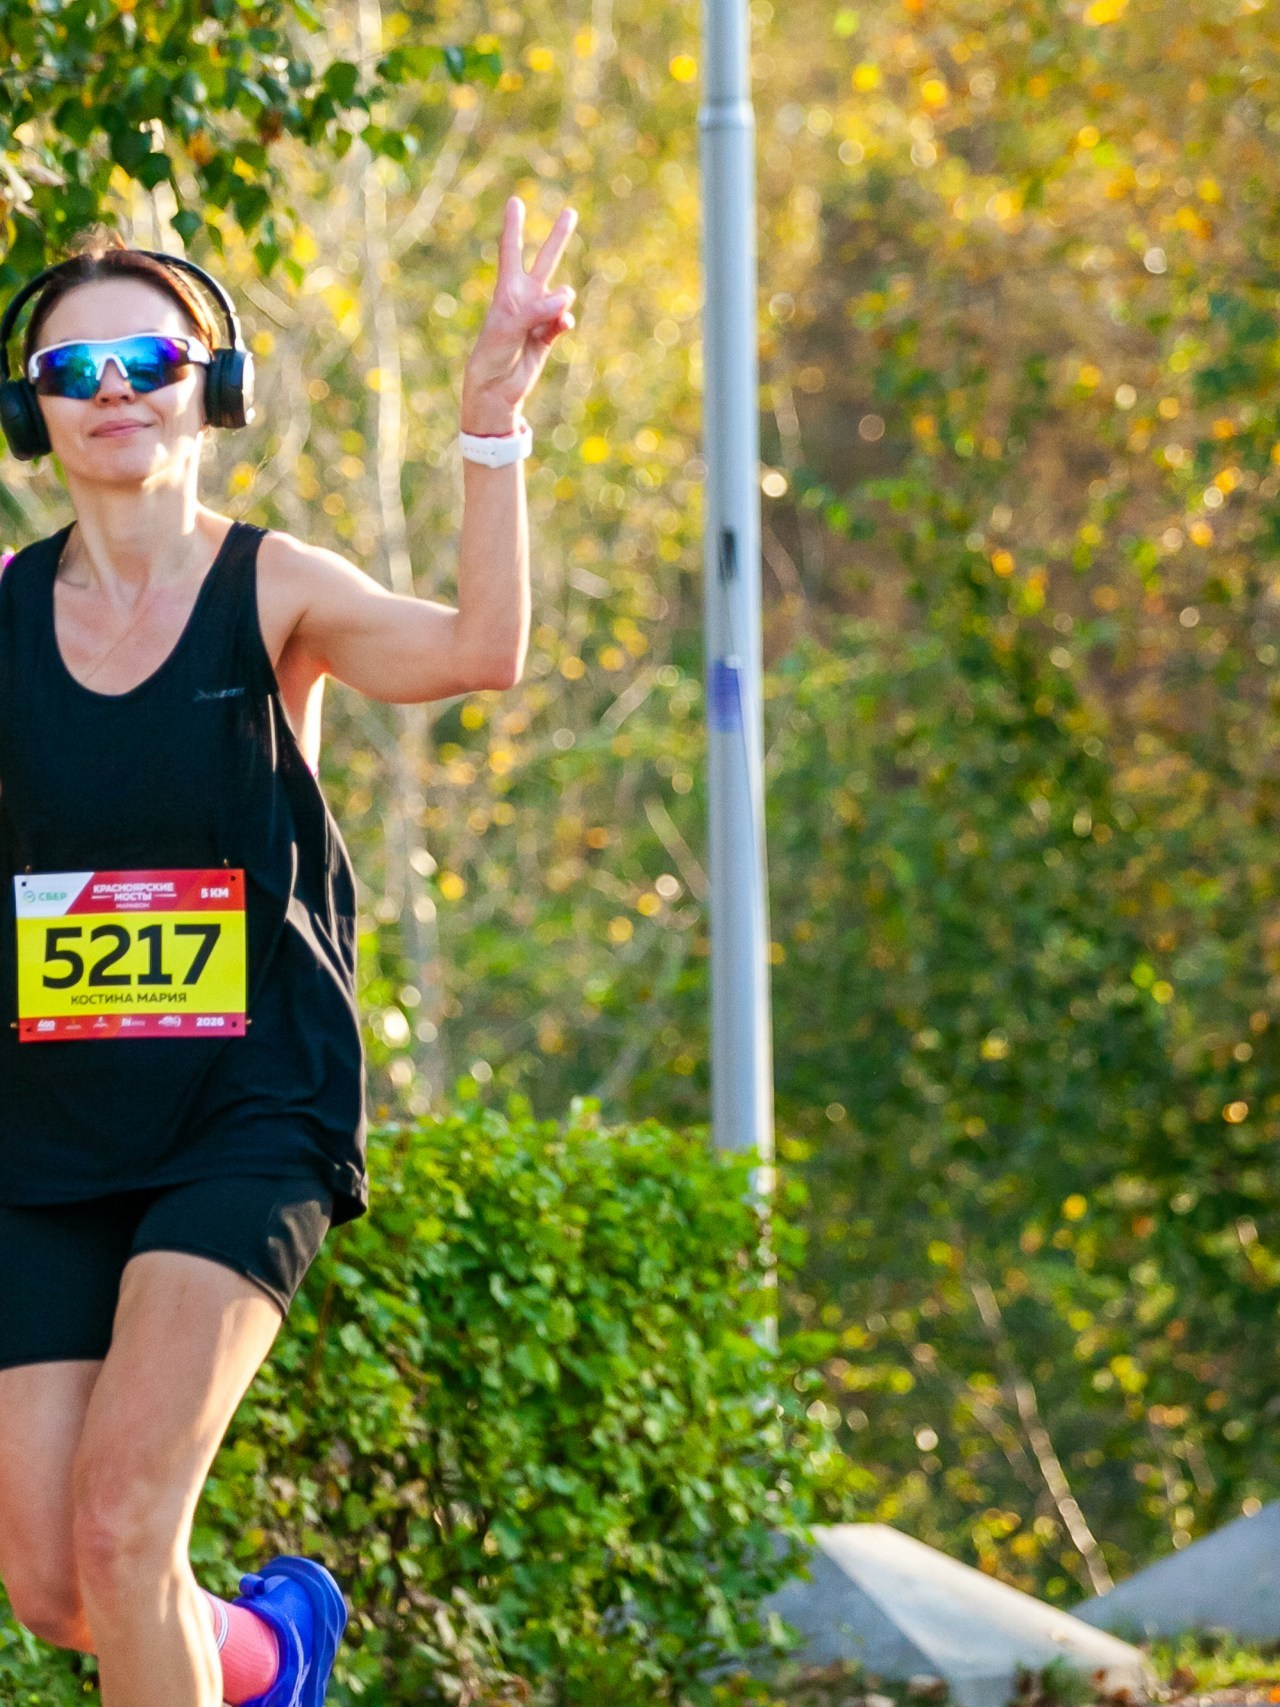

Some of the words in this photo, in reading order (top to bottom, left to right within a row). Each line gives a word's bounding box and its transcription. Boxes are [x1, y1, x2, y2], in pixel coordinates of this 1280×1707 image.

[93, 882, 174, 893] КРАСНОЯРСКИЕ
[201, 888, 209, 898] 5
[210, 887, 229, 898] КМ
[38, 892, 67, 901] СБЕР
[114, 892, 152, 901] МОСТЫ
[42, 924, 221, 989] 5217
[71, 993, 134, 1005] КОСТИНА
[137, 992, 187, 1003] МАРИЯ
